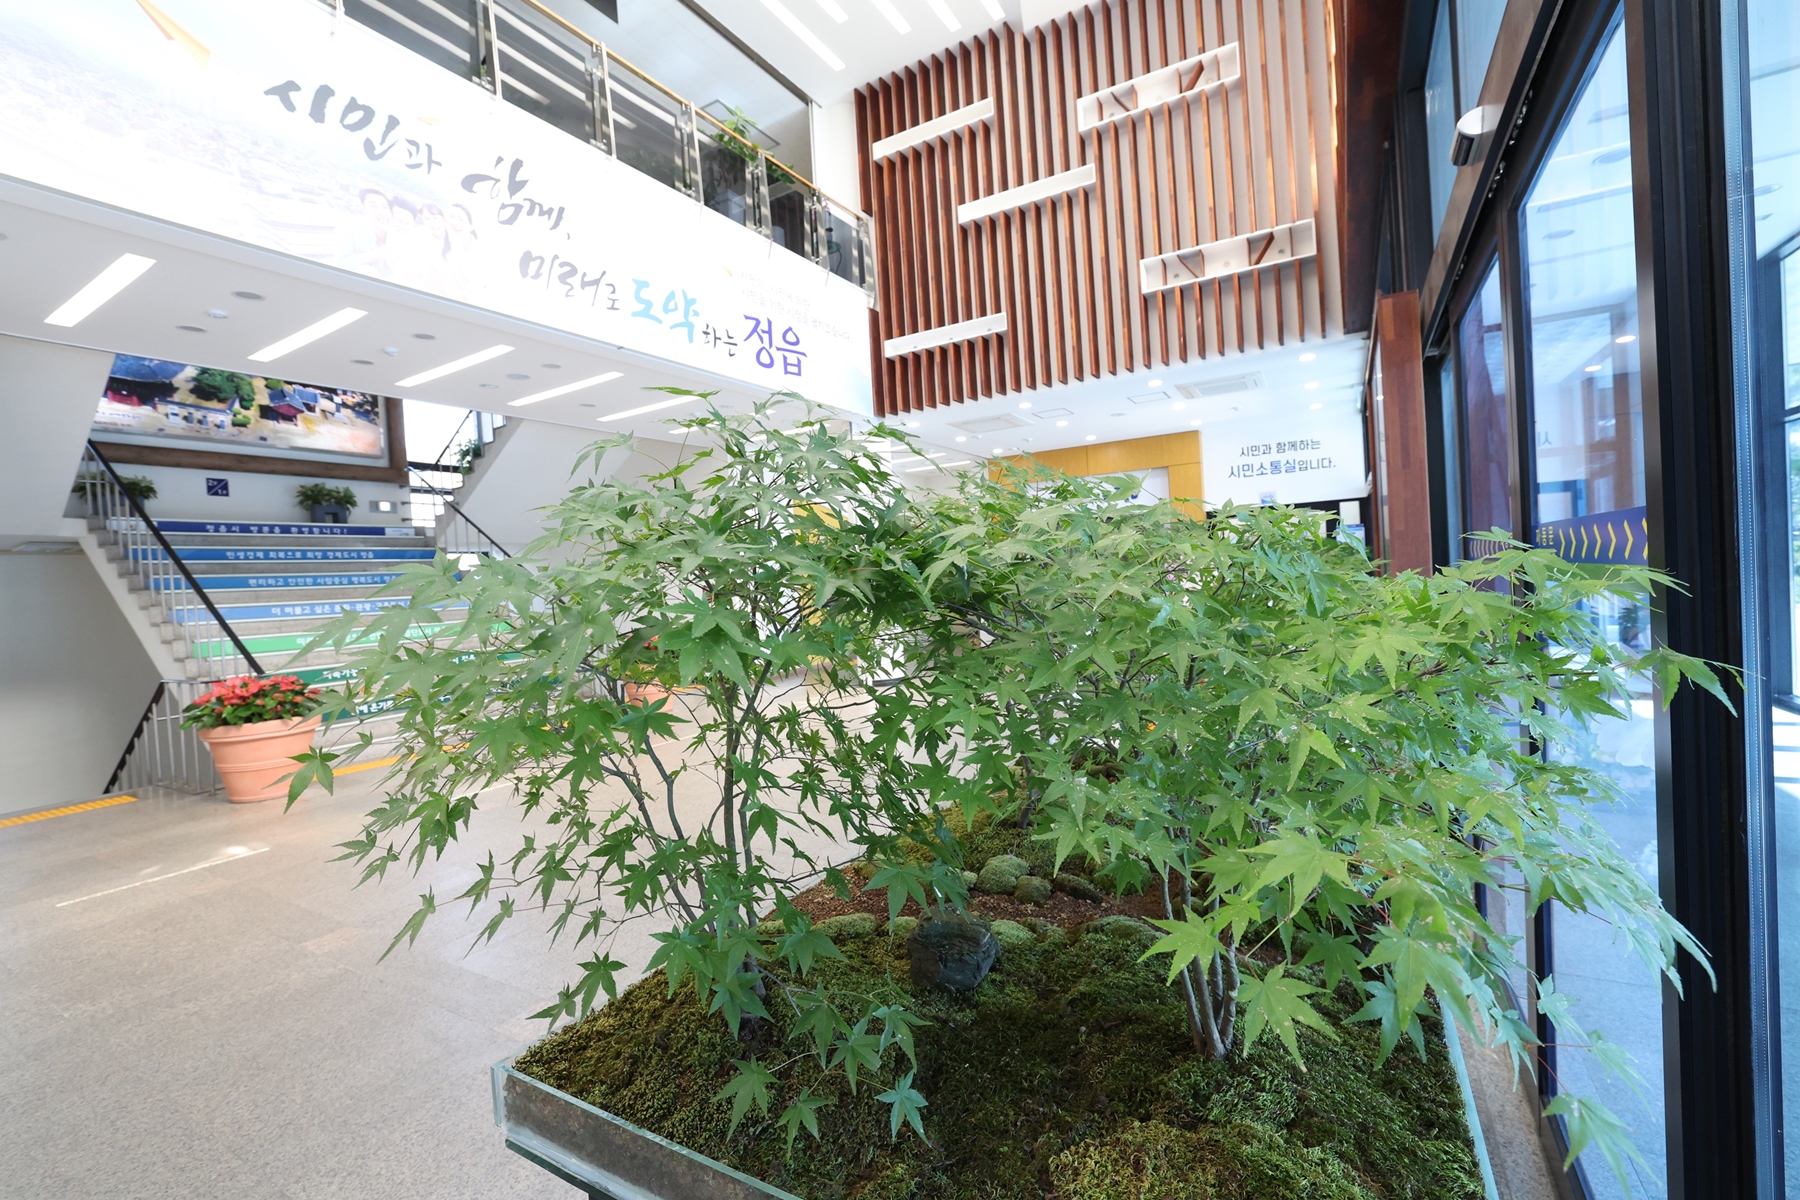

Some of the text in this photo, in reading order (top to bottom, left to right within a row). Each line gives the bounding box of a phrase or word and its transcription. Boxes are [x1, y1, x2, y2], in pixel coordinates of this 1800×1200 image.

[264, 80, 571, 241] 시민과 함께,
[519, 250, 620, 312] 미래로
[743, 314, 808, 377] 정읍
[1239, 438, 1321, 458] 시민과 함께하는
[1228, 457, 1336, 479] 시민소통실입니다.
[205, 524, 348, 535] 정읍시 방문을 환영합니다!
[271, 607, 281, 616] 더
